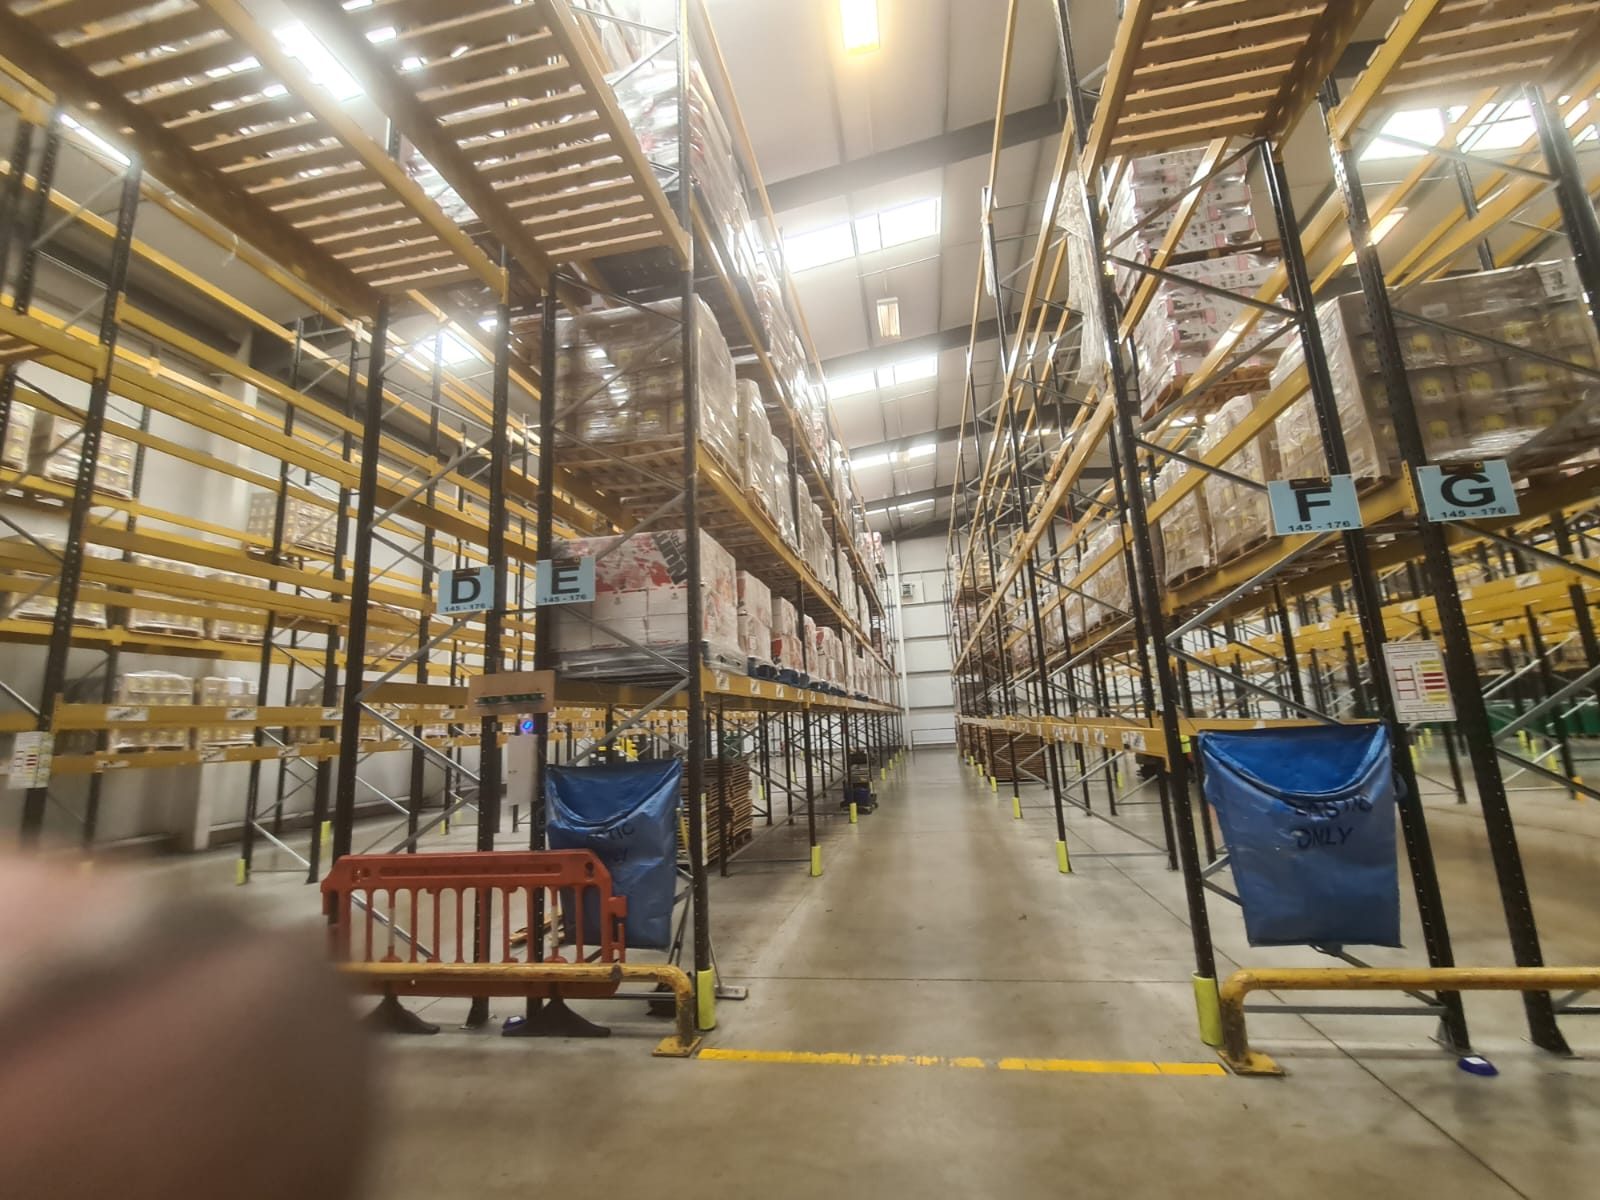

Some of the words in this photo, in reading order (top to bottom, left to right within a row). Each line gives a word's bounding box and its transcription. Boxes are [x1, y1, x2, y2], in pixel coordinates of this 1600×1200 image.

[1441, 473, 1496, 507] G
[1295, 487, 1332, 522] F
[1441, 510, 1466, 518] 145
[1480, 506, 1506, 515] 176
[1288, 523, 1312, 532] 145
[1327, 520, 1351, 529] 176
[451, 576, 481, 604] D
[552, 567, 580, 595] E
[1297, 826, 1354, 849] ONLY
